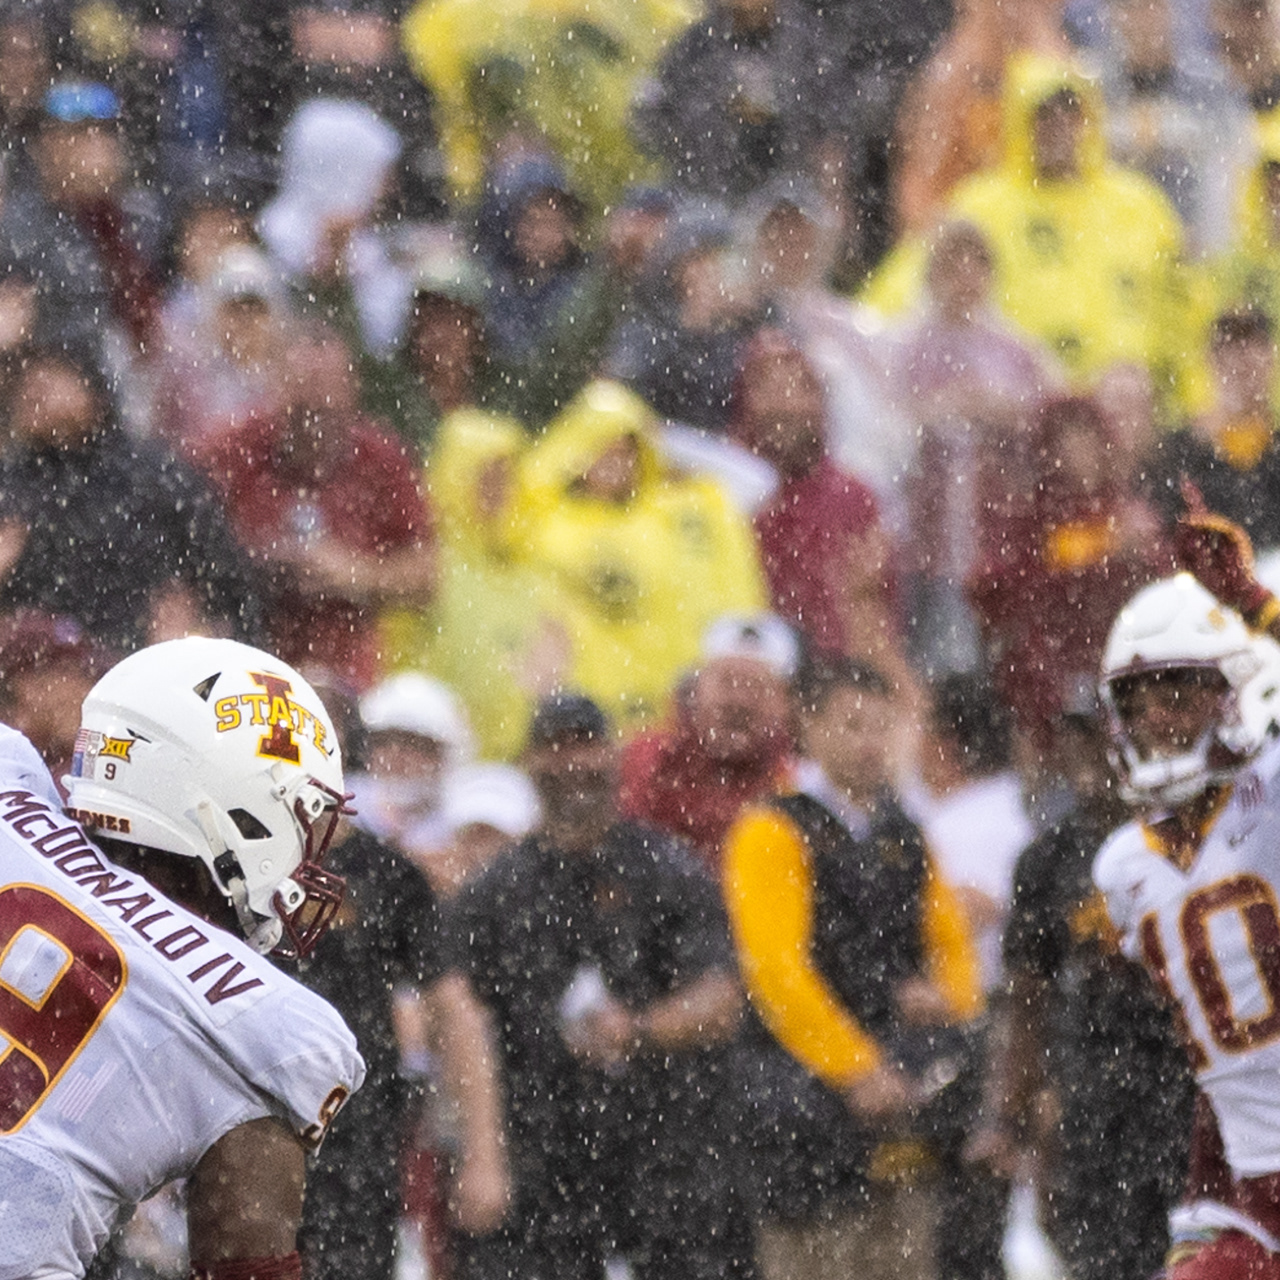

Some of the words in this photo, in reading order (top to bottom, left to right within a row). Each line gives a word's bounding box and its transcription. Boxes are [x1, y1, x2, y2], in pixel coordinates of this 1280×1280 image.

[214, 693, 330, 761] STATE
[103, 762, 117, 781] 9
[186, 952, 265, 1006] IV
